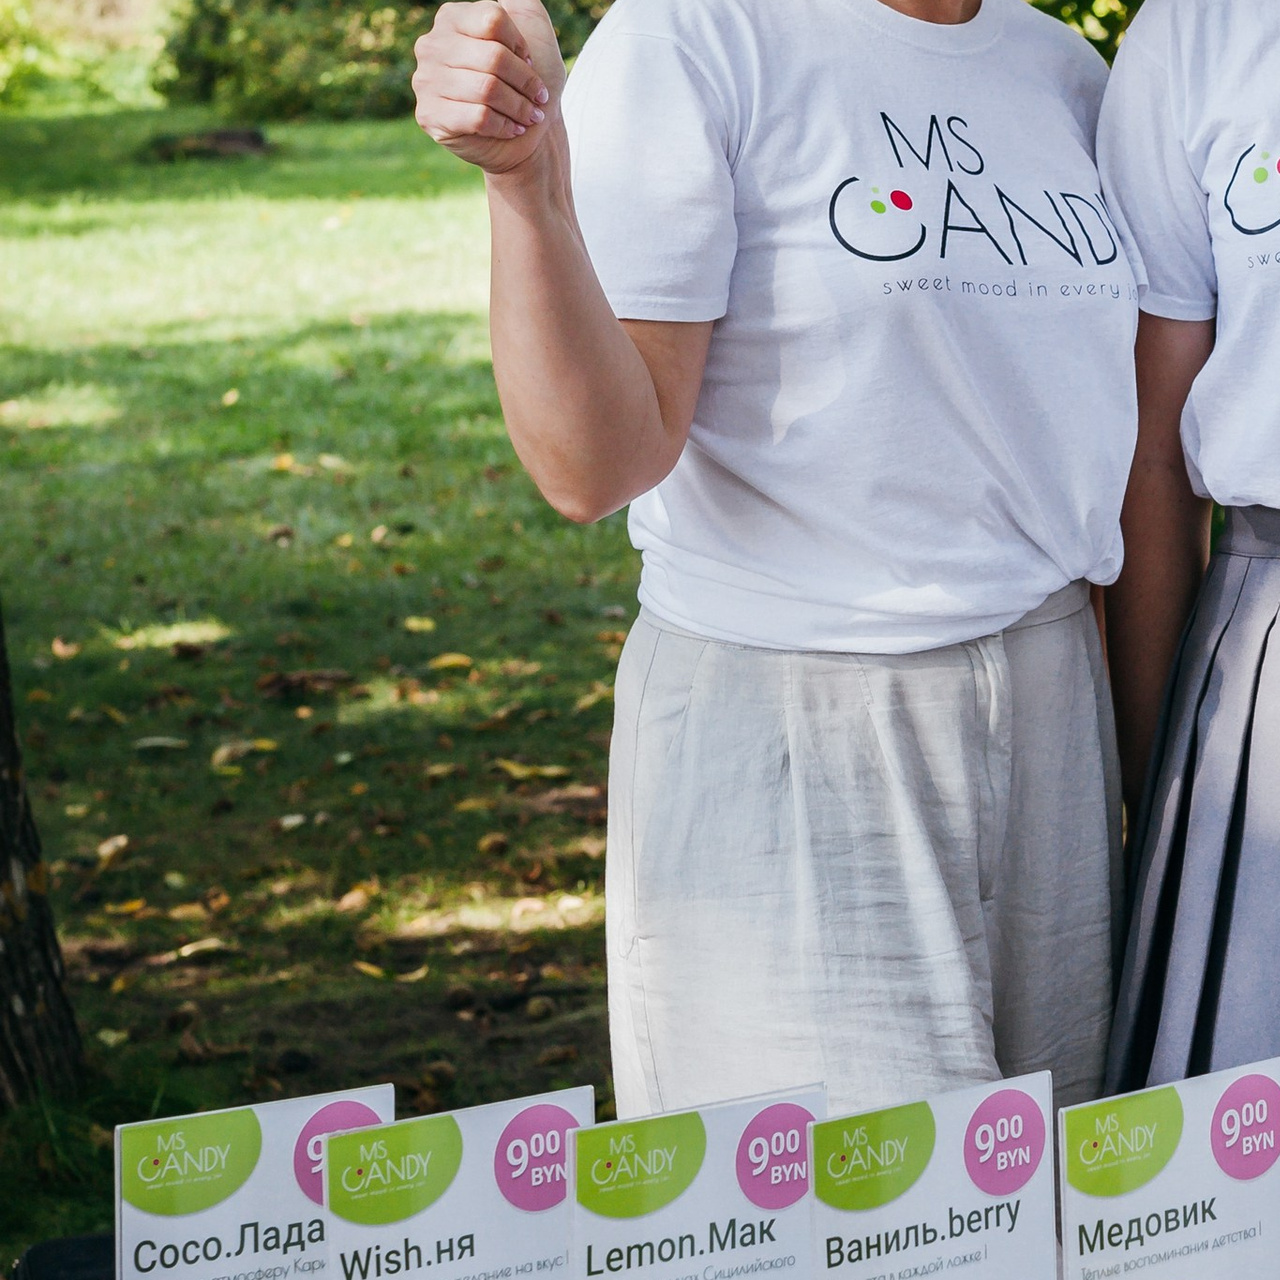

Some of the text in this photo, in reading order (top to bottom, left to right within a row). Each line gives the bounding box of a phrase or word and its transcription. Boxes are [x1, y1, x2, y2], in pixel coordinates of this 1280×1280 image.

[879, 111, 985, 176] MS
[883, 275, 950, 295] sweet
[962, 279, 1017, 297] mood
[1028, 281, 1048, 297] in
[1060, 283, 1120, 299] every
[1242, 1130, 1275, 1156] BYN
[996, 1145, 1031, 1171] BYN
[531, 1163, 567, 1186] BYN
[771, 1161, 807, 1184] BYN
[825, 1199, 1021, 1269] Ваниль.berry
[1078, 1197, 1217, 1256] Медовик
[516, 1261, 533, 1275] на
[898, 1256, 944, 1280] каждой
[1124, 1239, 1209, 1272] воспоминания
